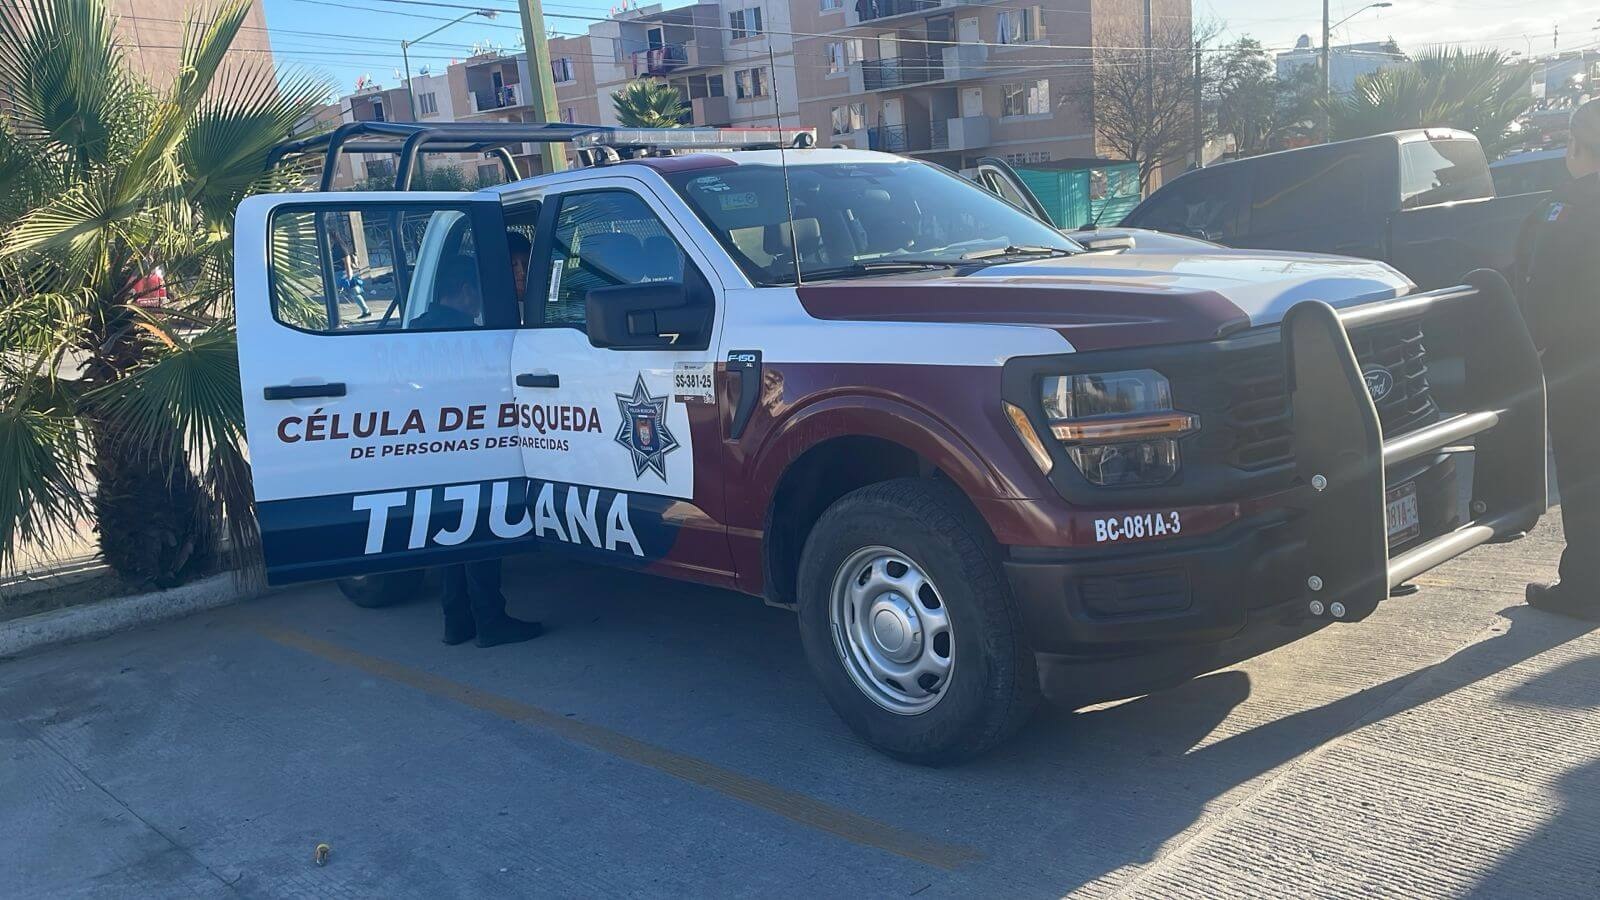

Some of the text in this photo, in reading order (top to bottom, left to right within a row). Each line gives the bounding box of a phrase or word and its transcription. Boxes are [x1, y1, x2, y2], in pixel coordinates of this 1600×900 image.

[728, 354, 756, 362] F-150
[675, 374, 712, 388] SS-381-25
[277, 408, 425, 443] CÉLULA
[438, 404, 486, 433] DE
[350, 446, 376, 460] DE
[381, 438, 480, 457] PERSONAS
[352, 480, 645, 557] TIJUANA
[1094, 511, 1181, 542] BC-081A-3
